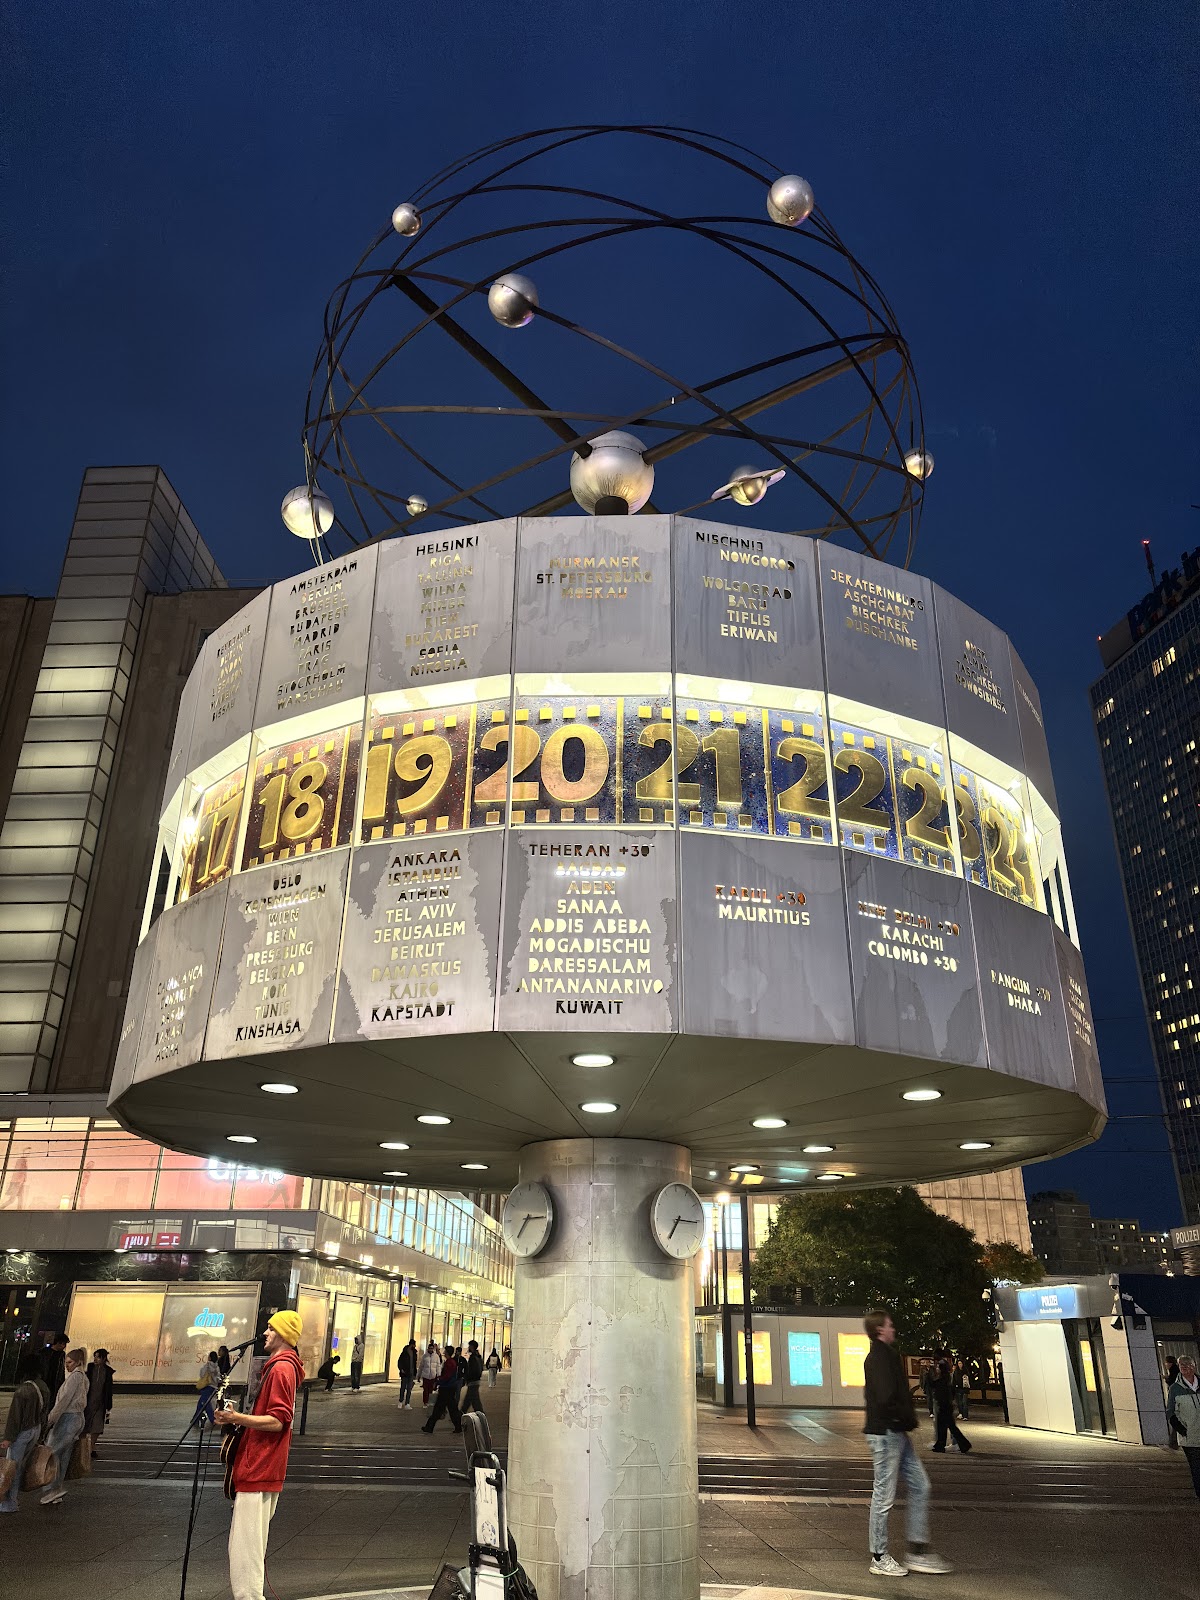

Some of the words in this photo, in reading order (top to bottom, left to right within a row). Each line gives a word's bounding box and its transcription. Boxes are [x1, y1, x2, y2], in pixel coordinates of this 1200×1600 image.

[416, 536, 479, 556] HELSINKI
[430, 553, 462, 568] RIGA
[549, 556, 640, 569] MURMANSK
[720, 549, 795, 571] NOWGOROD
[290, 560, 357, 595] AMSTERDAM
[418, 565, 473, 584] TALLINN
[536, 573, 555, 584] ST.
[560, 571, 653, 584] PETERSBURG
[301, 580, 342, 603] BERLIN
[422, 582, 466, 598] WILNA
[562, 586, 628, 599] MOSKAU
[702, 576, 792, 599] WOLGOGRAD
[830, 569, 924, 611] JEKATERINBURG
[420, 596, 465, 614] MINSK
[728, 594, 767, 611] BAKU
[844, 589, 915, 621] ASCHGABAT
[290, 604, 349, 636] BUDAPEST
[425, 612, 460, 628] KIEW
[727, 610, 771, 627] TIFLIS
[851, 604, 909, 634] BISCHKEK
[293, 623, 340, 649] MADRID
[405, 624, 479, 647] BUKAREST
[720, 624, 778, 643] ERIWAN
[845, 616, 918, 650] DUSCHANBE
[299, 640, 332, 660] PARIS
[419, 644, 460, 660] SOFIA
[297, 653, 329, 675] PRAG
[410, 657, 467, 676] NIKOSIA
[277, 663, 346, 696] STOCKHOLM
[277, 679, 343, 710] WARSCHAU
[259, 761, 328, 849] 18
[361, 734, 453, 820] 19
[474, 724, 609, 804] 20
[635, 722, 743, 806] 21
[777, 738, 890, 831] 22
[903, 767, 981, 861] 23
[985, 807, 1034, 902] 24
[391, 848, 461, 868] ANKARA
[529, 844, 610, 857] TEHERAN
[273, 874, 301, 890] OSLO
[387, 866, 462, 887] ISTANBUL
[396, 884, 450, 904] ATHEN
[566, 880, 616, 895] ADEN
[715, 884, 771, 904] KABUL
[244, 884, 327, 915] KOPENHAGEN
[557, 899, 623, 914] SANAA
[268, 907, 300, 927] WIEN
[386, 908, 412, 924] TEL
[418, 902, 457, 920] AVIV
[719, 903, 810, 926] MAURITIUS
[894, 908, 932, 930] DELHI
[265, 926, 297, 946] BERN
[373, 920, 466, 944] JERUSALEM
[529, 918, 584, 933] ADDIS
[592, 919, 651, 934] ABEBA
[529, 938, 650, 954] MOGADISCHU
[881, 924, 944, 951] KARACHI
[246, 941, 314, 968] PRESSBURG
[390, 942, 445, 961] BEIRUT
[868, 940, 928, 966] COLOMBO
[249, 961, 305, 985] BELGRAD
[371, 960, 462, 983] DAMASKUS
[528, 957, 651, 973] DARESSALAM
[262, 983, 287, 1001] ROM
[389, 982, 439, 1000] KAIRO
[515, 977, 664, 994] ANTANANARIVO
[990, 969, 1030, 995] RANGUN
[255, 1001, 291, 1020] TUNIS
[371, 1001, 456, 1022] KAPSTADT
[555, 999, 623, 1014] KUWAIT
[1007, 992, 1042, 1016] DHAKA
[235, 1018, 301, 1042] KINSHASA
[1176, 1229, 1200, 1244] POLIZEI
[194, 1307, 225, 1328] dm
